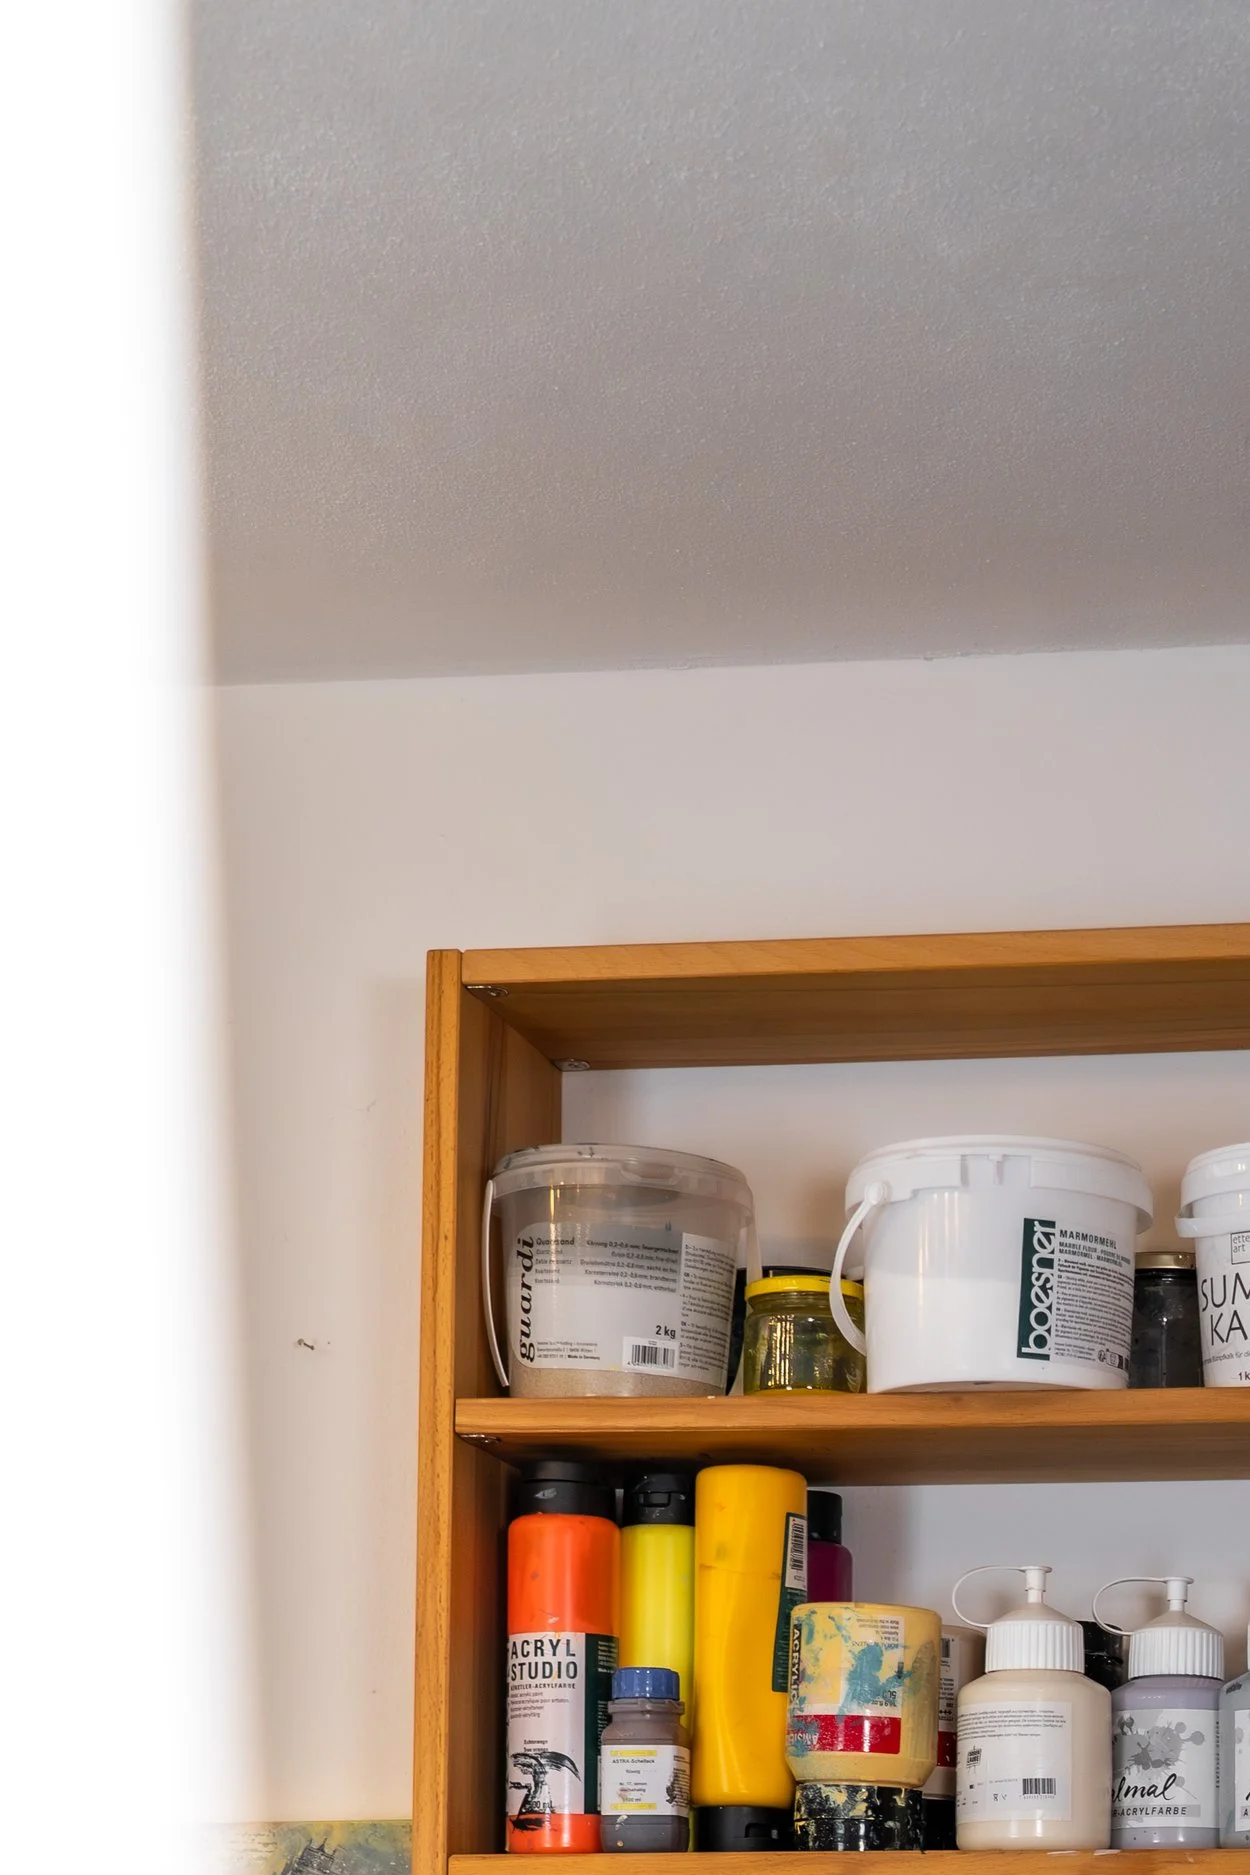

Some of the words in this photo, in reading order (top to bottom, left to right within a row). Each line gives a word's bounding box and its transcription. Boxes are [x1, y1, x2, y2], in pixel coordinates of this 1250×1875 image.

[1060, 1230, 1117, 1249] MARMORMEHL
[1232, 1243, 1246, 1253] art
[1021, 1221, 1056, 1355] boesner
[516, 1236, 534, 1363] guardi
[655, 1325, 662, 1336] 2
[664, 1325, 676, 1339] kg
[1238, 1372, 1242, 1380] 1
[510, 1638, 576, 1659] ACRYL
[510, 1662, 578, 1682] STUDIO
